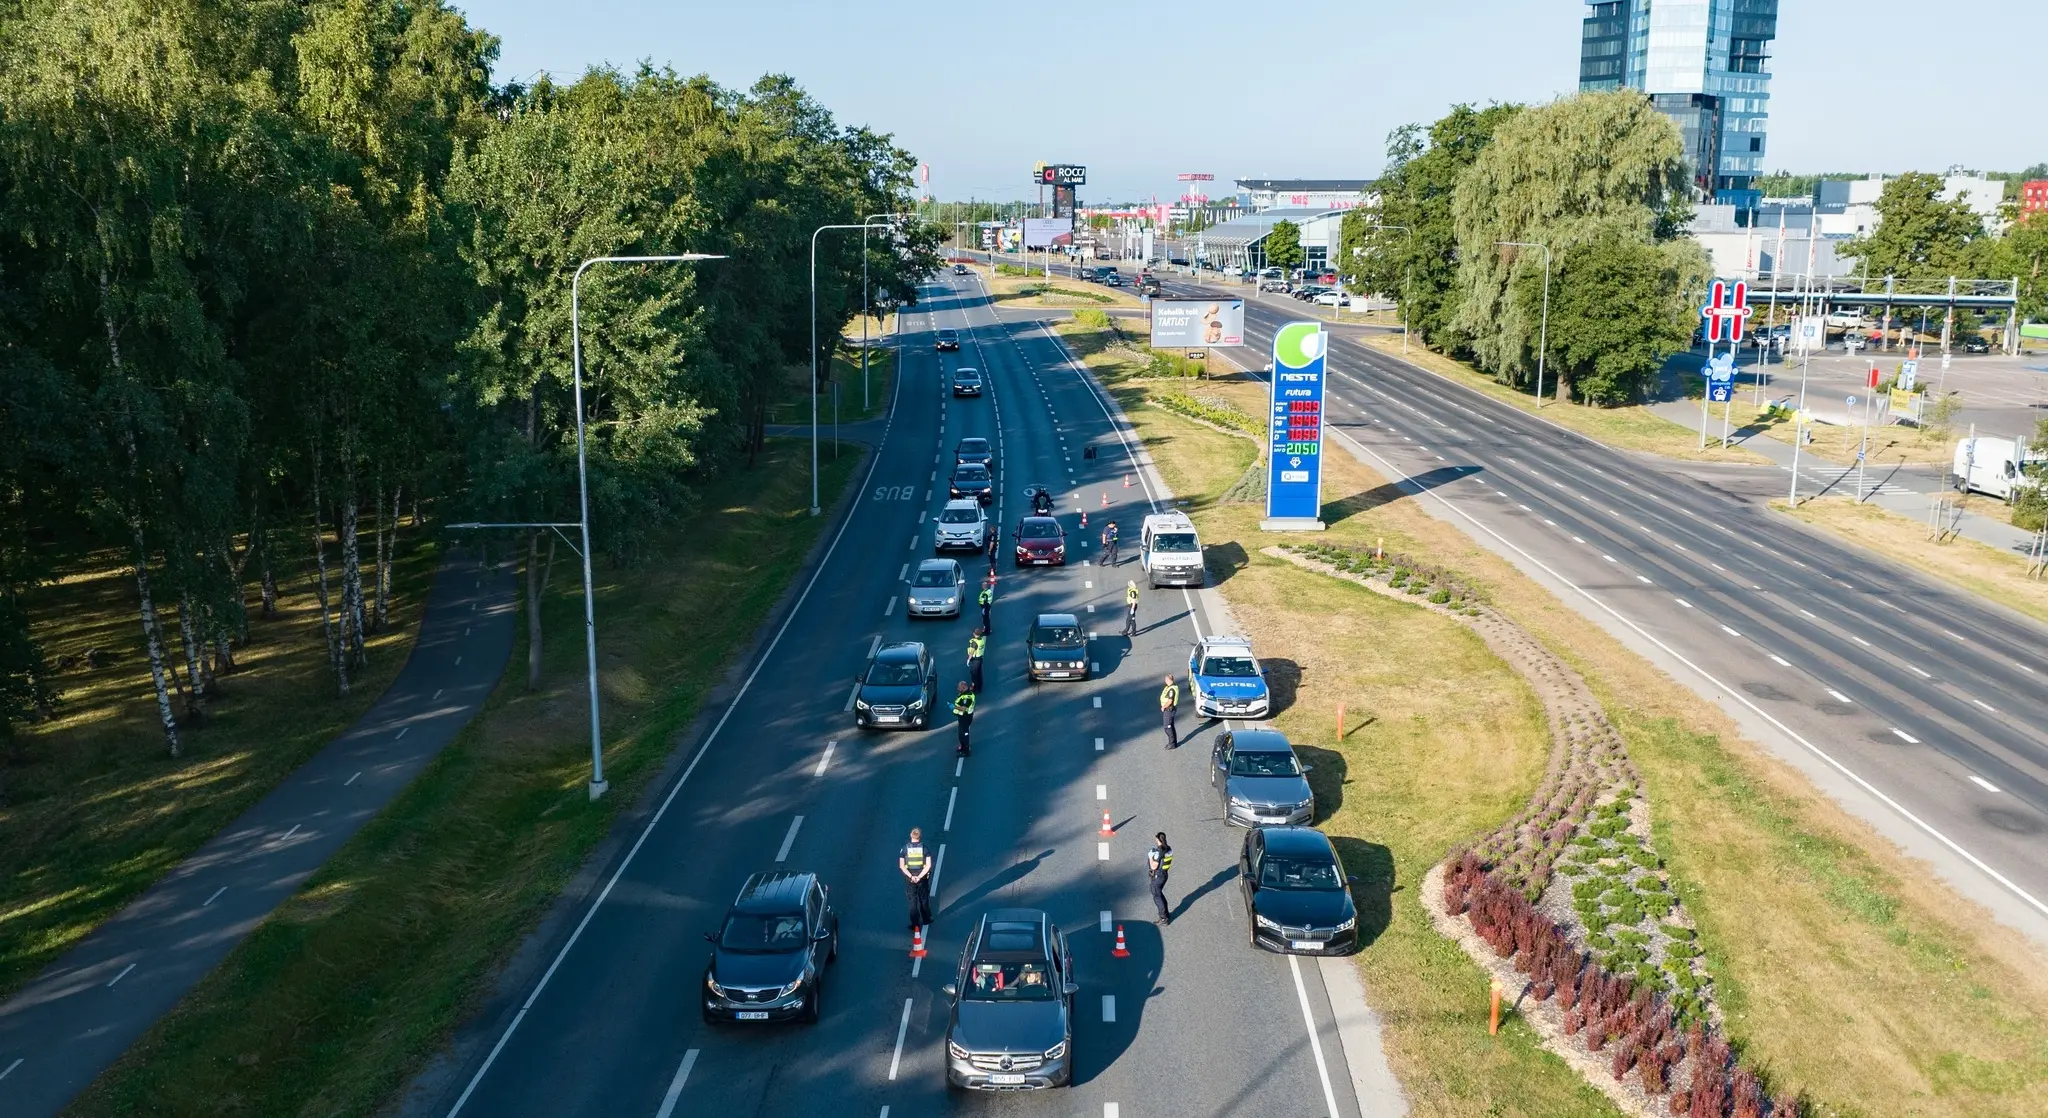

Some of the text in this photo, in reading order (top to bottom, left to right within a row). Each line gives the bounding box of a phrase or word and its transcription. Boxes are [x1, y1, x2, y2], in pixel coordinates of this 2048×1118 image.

[1158, 317, 1190, 327] TARTUST
[1280, 373, 1318, 381] NESTE
[872, 485, 915, 501] BUS
